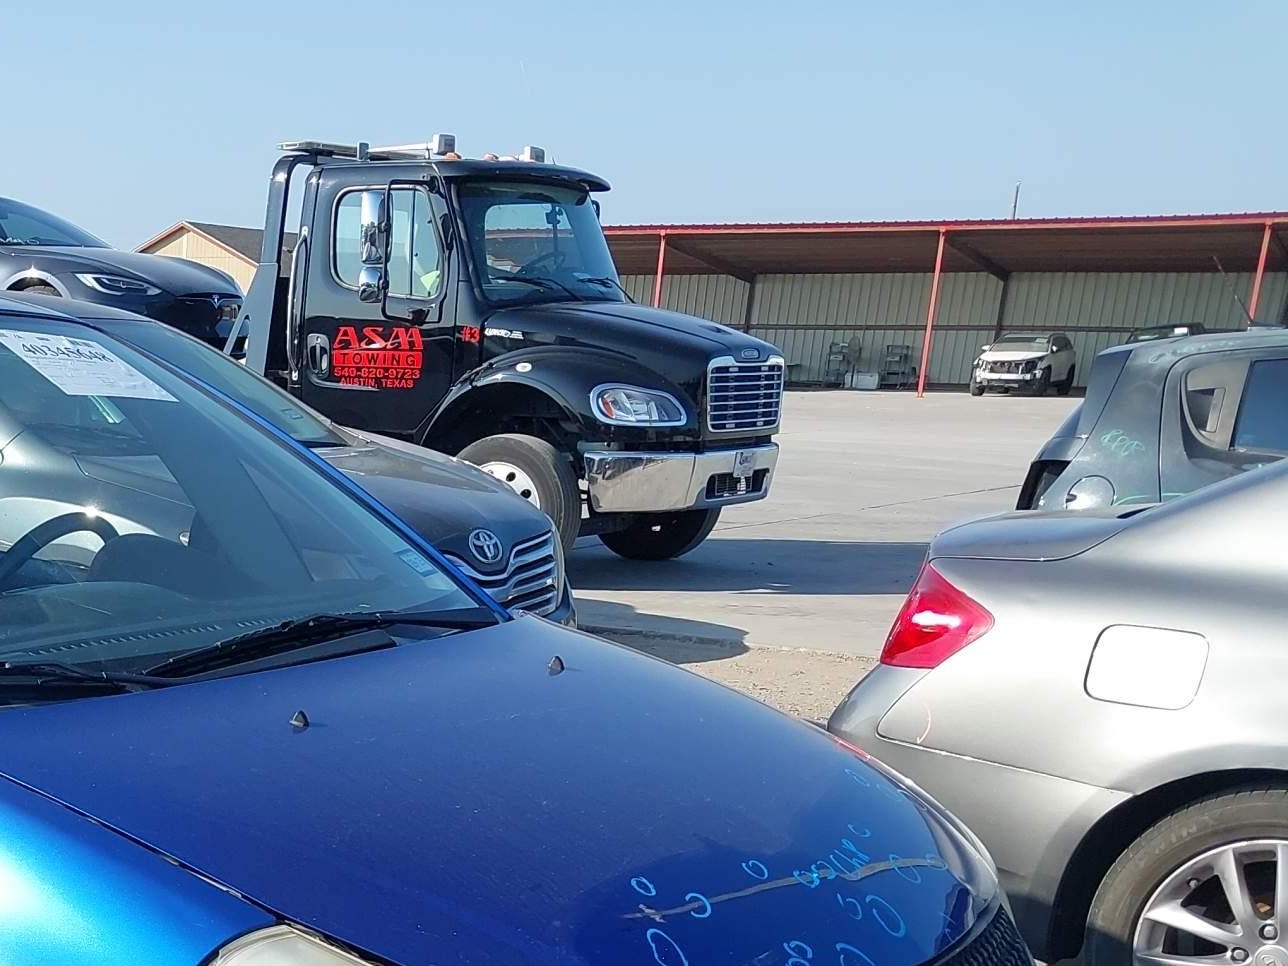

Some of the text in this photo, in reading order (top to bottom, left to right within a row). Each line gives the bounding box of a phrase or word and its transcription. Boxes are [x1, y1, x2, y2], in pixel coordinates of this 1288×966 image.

[332, 325, 424, 350] ASM
[460, 327, 481, 344] #3
[21, 342, 114, 363] 40345648
[339, 352, 417, 367] TOWING
[380, 378, 415, 389] TEXAS
